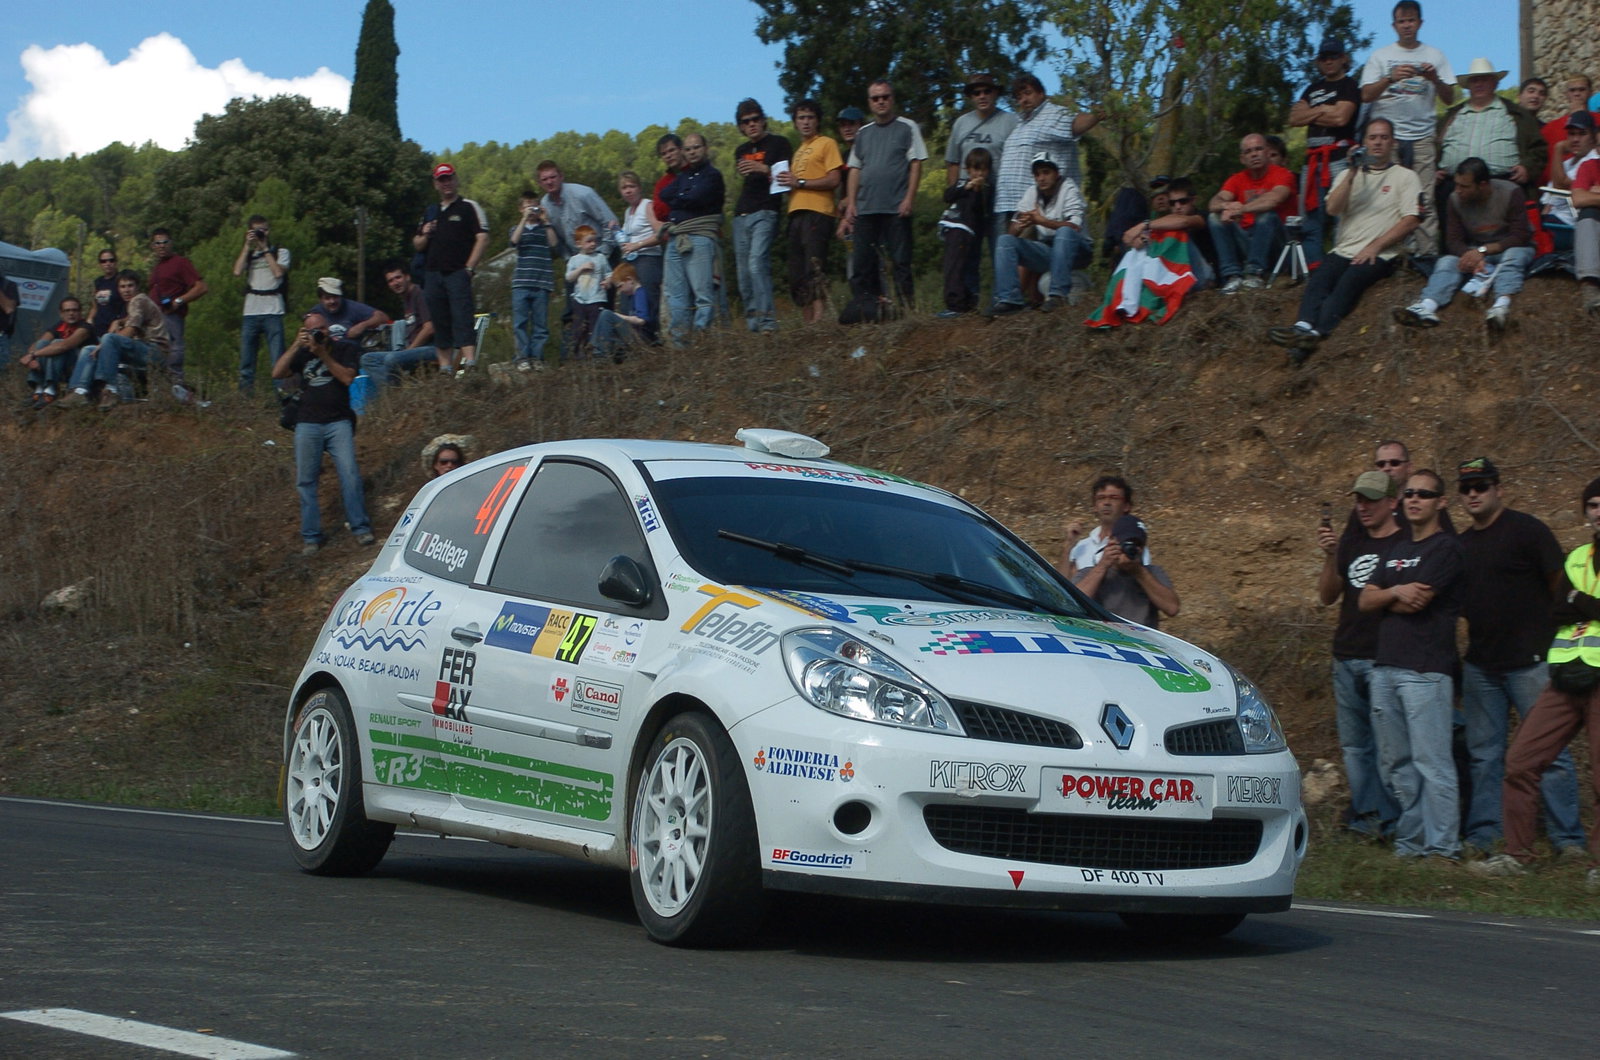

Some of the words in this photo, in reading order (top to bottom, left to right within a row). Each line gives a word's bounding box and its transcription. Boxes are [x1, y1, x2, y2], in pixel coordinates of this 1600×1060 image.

[474, 466, 527, 535] 47
[639, 500, 660, 533] TRT
[424, 533, 469, 572] Bettega
[508, 622, 541, 637] movistar
[547, 613, 570, 631] RACC
[680, 584, 780, 655] Telefin
[559, 615, 599, 663] 47
[989, 631, 1174, 669] TRT
[316, 651, 331, 665] FOR
[334, 655, 356, 670] YOUR
[358, 658, 386, 674] BEACH
[387, 664, 421, 681] HOLIDAY
[439, 646, 477, 687] FER
[585, 686, 619, 705] Canol
[369, 712, 397, 726] RENAULT
[397, 717, 422, 728] SPORT
[431, 717, 473, 736] IMMOBILIARE
[388, 752, 422, 785] R3
[766, 761, 836, 782] ALBINESE
[768, 746, 839, 768] FONDERIA
[929, 760, 1027, 793] KEROX
[1060, 774, 1144, 801] POWER
[1151, 778, 1195, 803] CAR
[1226, 775, 1282, 804] KEROX
[1107, 789, 1160, 811] team
[771, 848, 853, 865] BFGoodrich
[1080, 868, 1105, 883] DF
[1111, 870, 1140, 885] 400
[1142, 872, 1165, 887] TV
